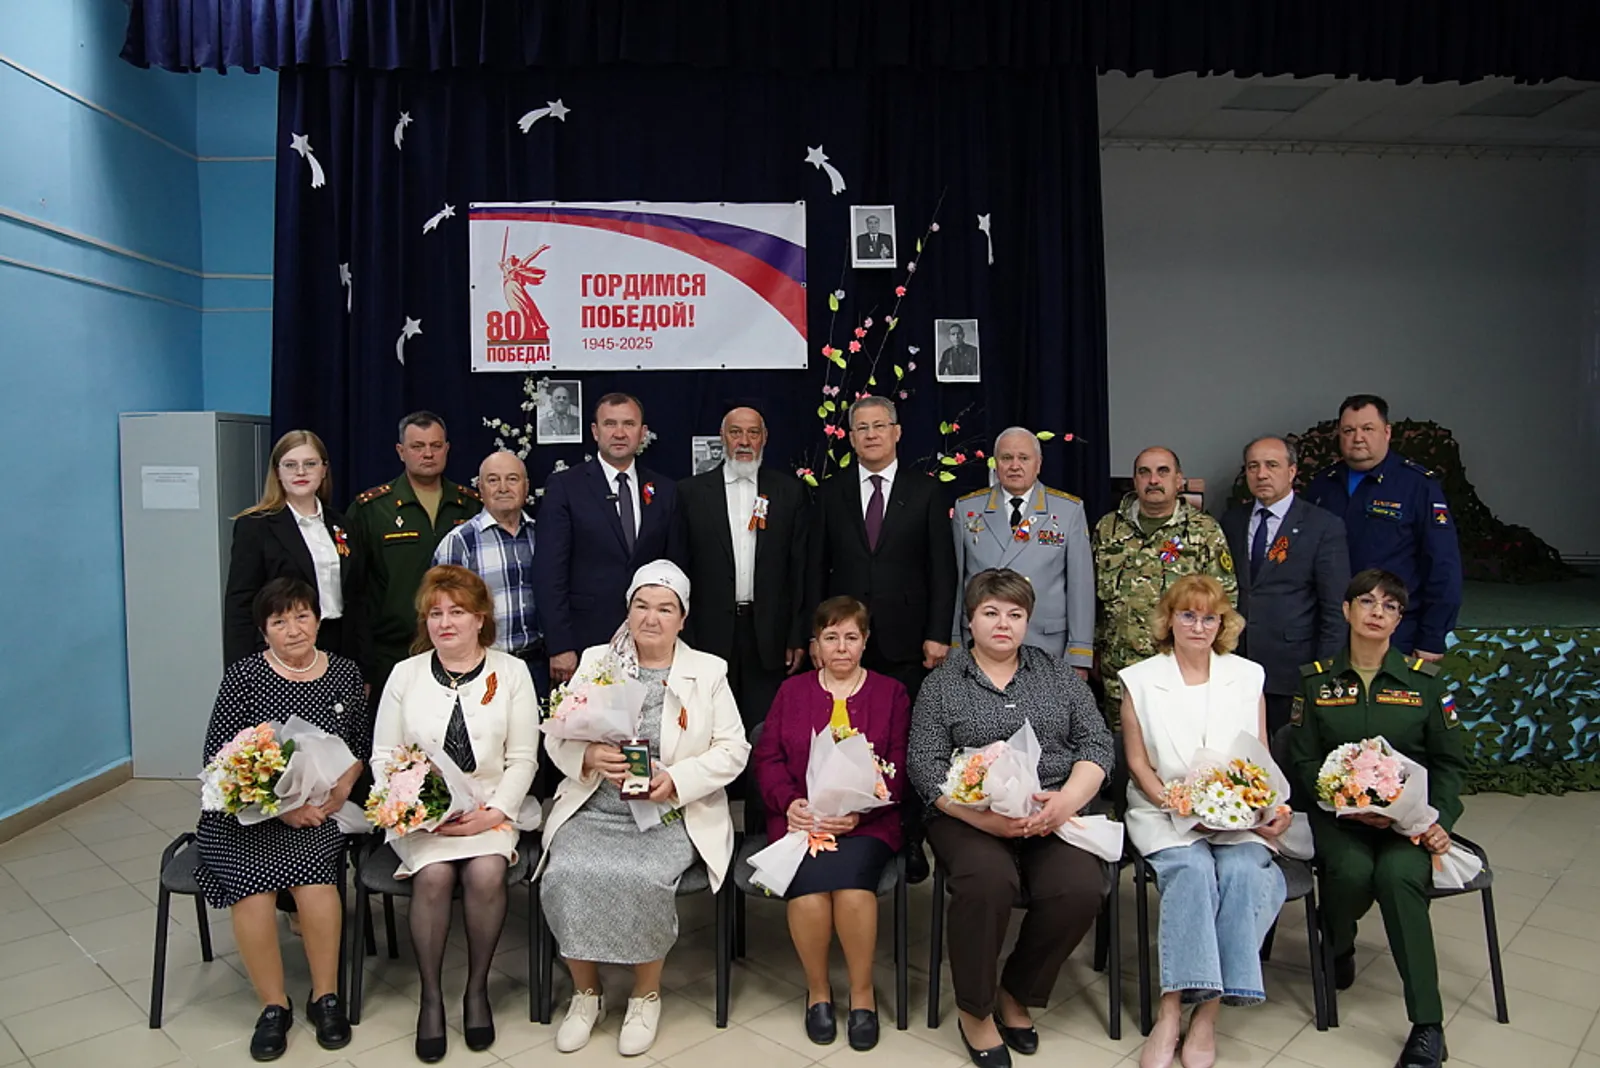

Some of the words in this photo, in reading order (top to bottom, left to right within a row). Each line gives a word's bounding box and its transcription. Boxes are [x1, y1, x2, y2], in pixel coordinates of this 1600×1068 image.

[581, 274, 706, 300] ГОРДИМСЯ
[486, 310, 522, 340] 80
[581, 302, 695, 331] ПОБЕДОЙ!
[487, 346, 551, 364] ПОБЕДА!
[581, 337, 653, 350] 1945-2025
